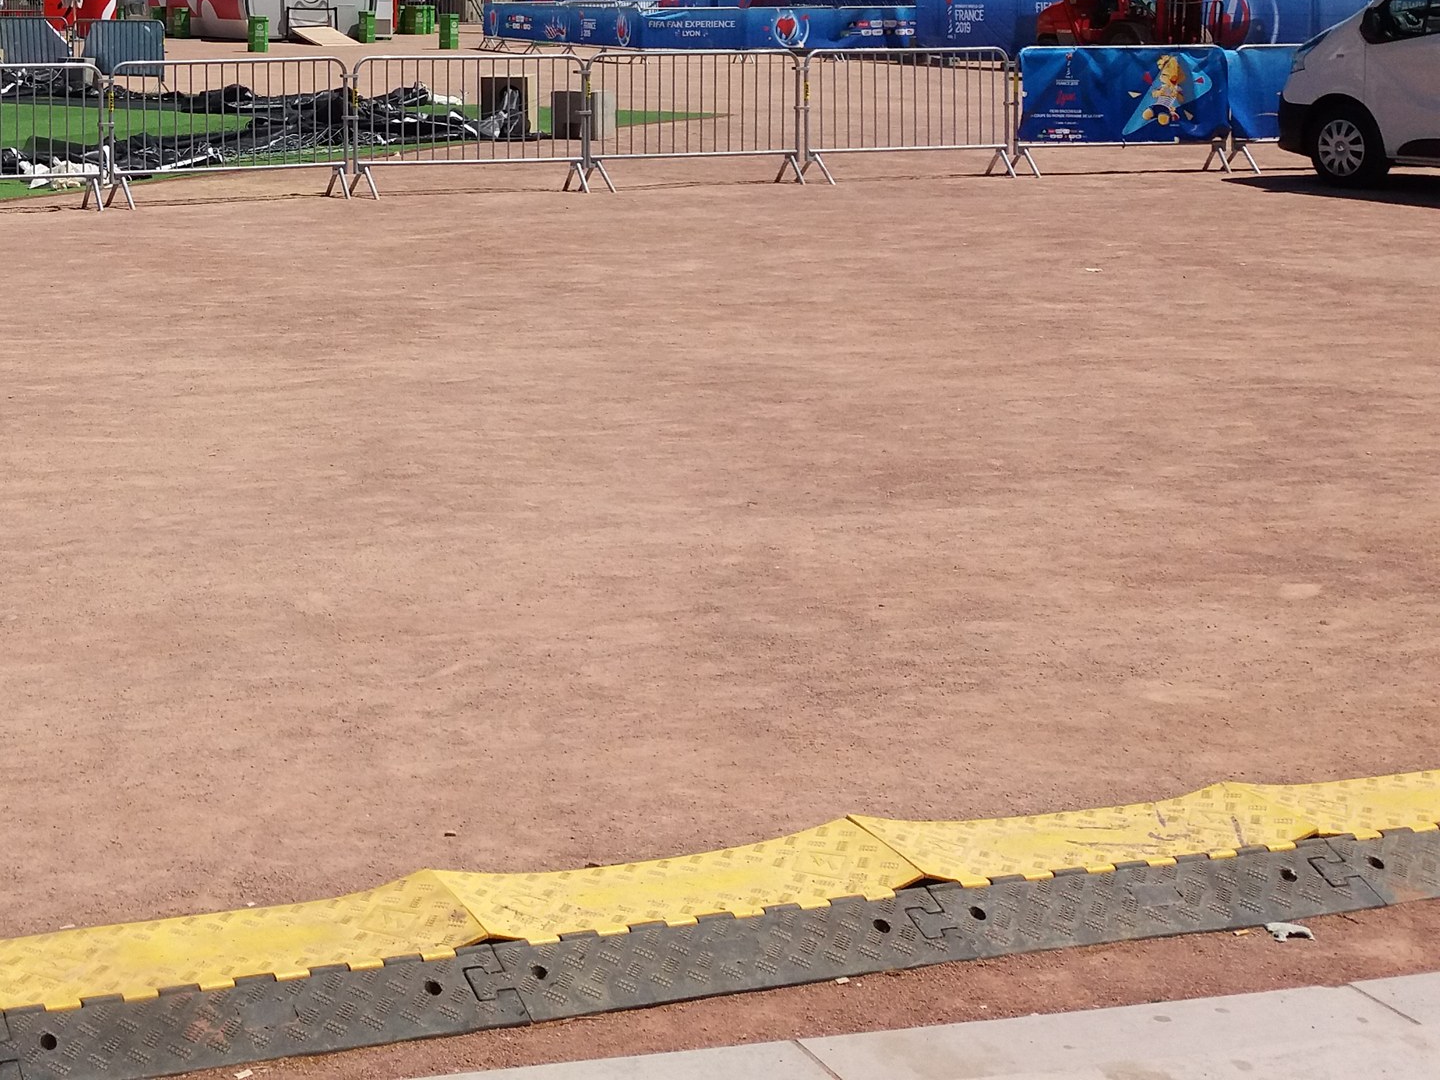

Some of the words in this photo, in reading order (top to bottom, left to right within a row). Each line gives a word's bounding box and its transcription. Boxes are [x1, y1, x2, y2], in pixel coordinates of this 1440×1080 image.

[1035, 1, 1053, 13] FIF
[955, 9, 985, 22] FRANCE
[648, 20, 665, 28] FIFA
[667, 20, 683, 29] FAN
[685, 20, 736, 28] EXPERIENCE
[955, 21, 971, 34] 2019
